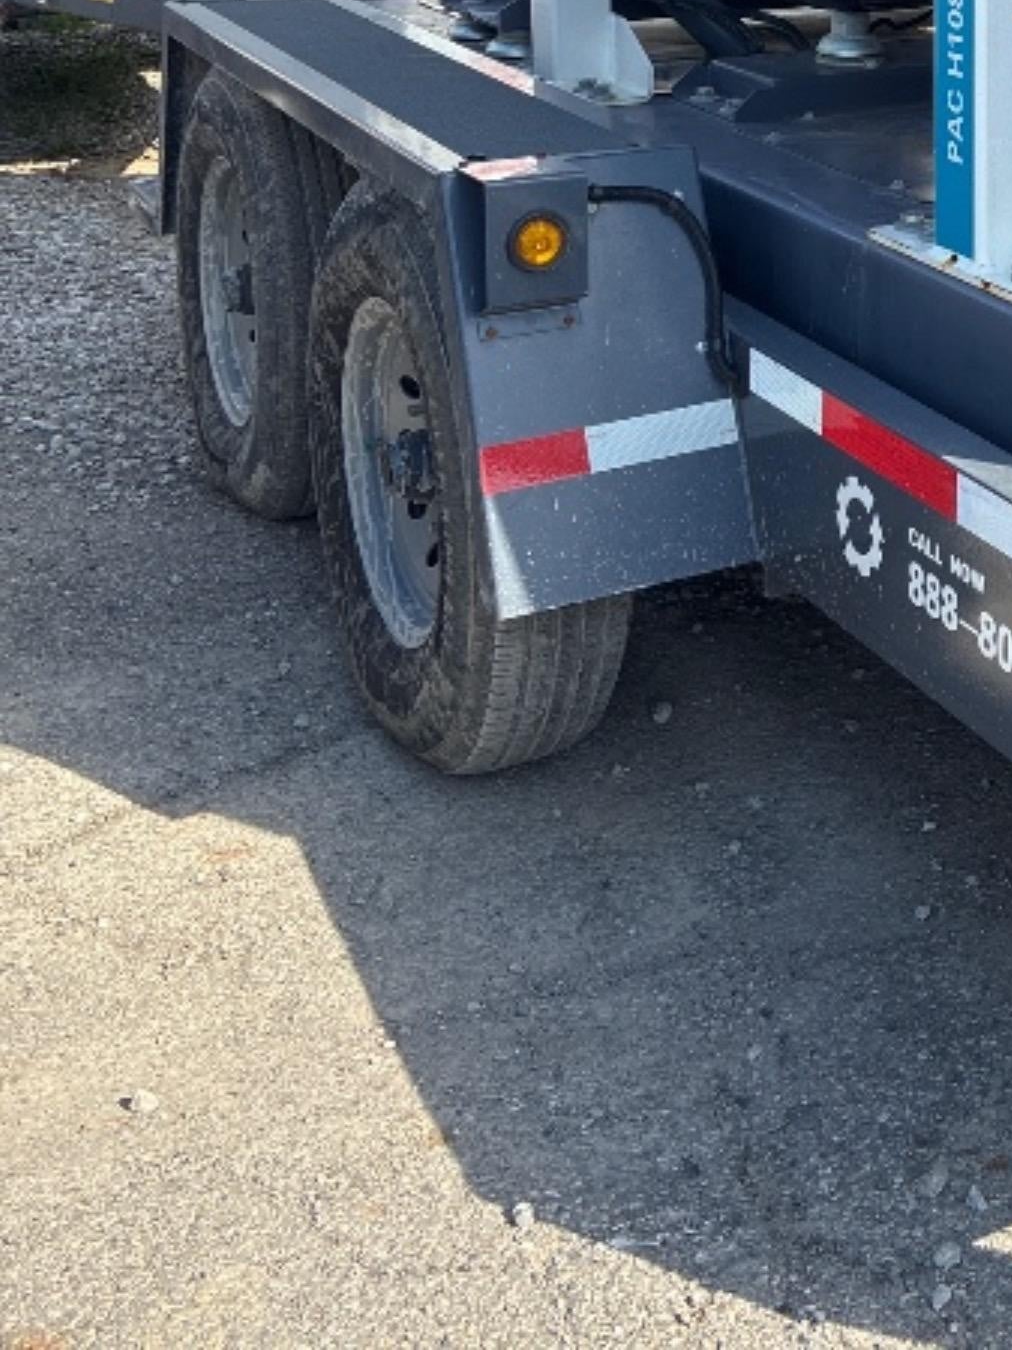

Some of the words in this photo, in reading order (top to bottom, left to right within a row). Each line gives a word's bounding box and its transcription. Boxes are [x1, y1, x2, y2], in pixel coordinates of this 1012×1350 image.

[947, 88, 964, 166] PAC
[907, 526, 943, 566] CALL
[950, 553, 986, 595] NOW
